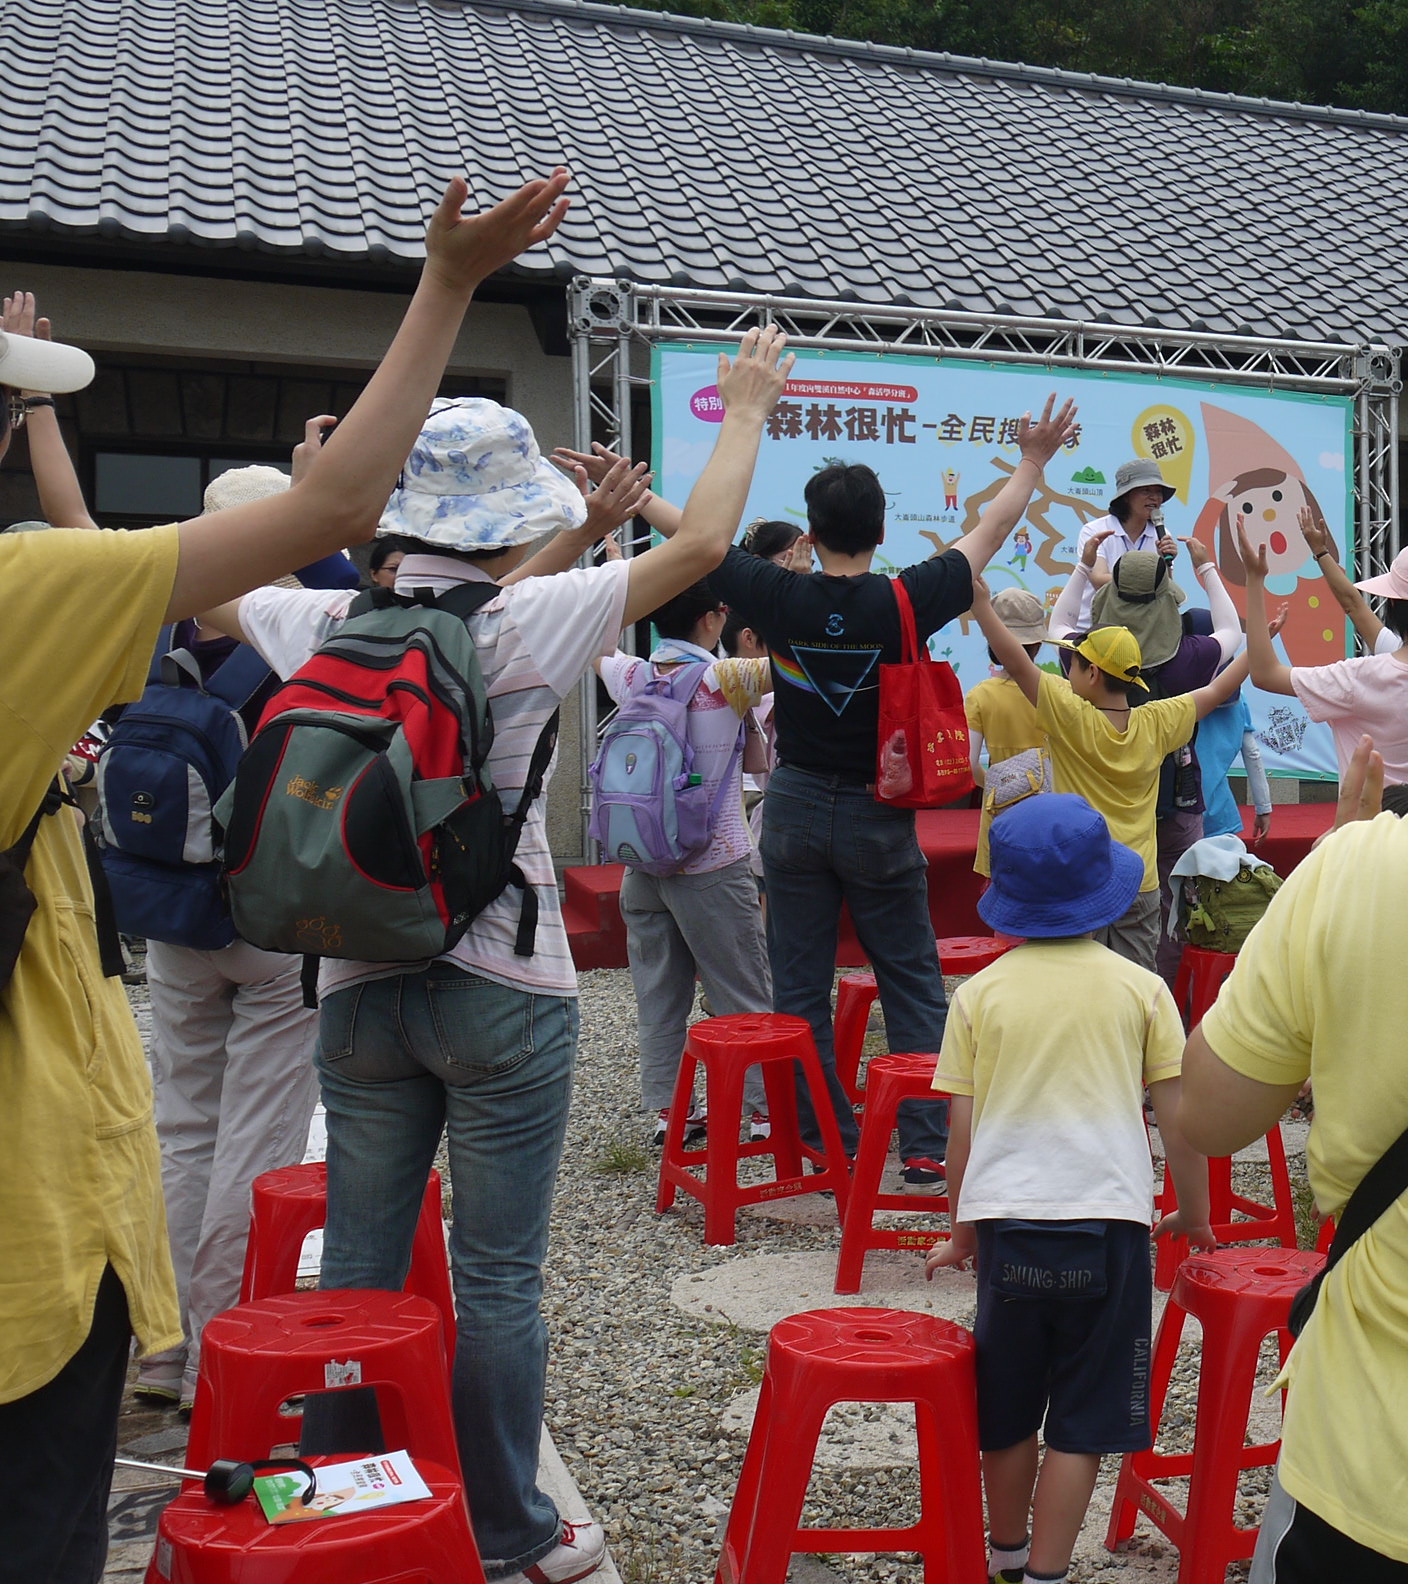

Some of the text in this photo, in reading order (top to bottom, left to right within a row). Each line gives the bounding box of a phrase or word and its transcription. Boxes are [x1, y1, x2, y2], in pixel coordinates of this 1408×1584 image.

[1143, 417, 1177, 442] 森林
[1150, 435, 1183, 459] 很忙
[1129, 1338, 1149, 1426] CALIFORNIA
